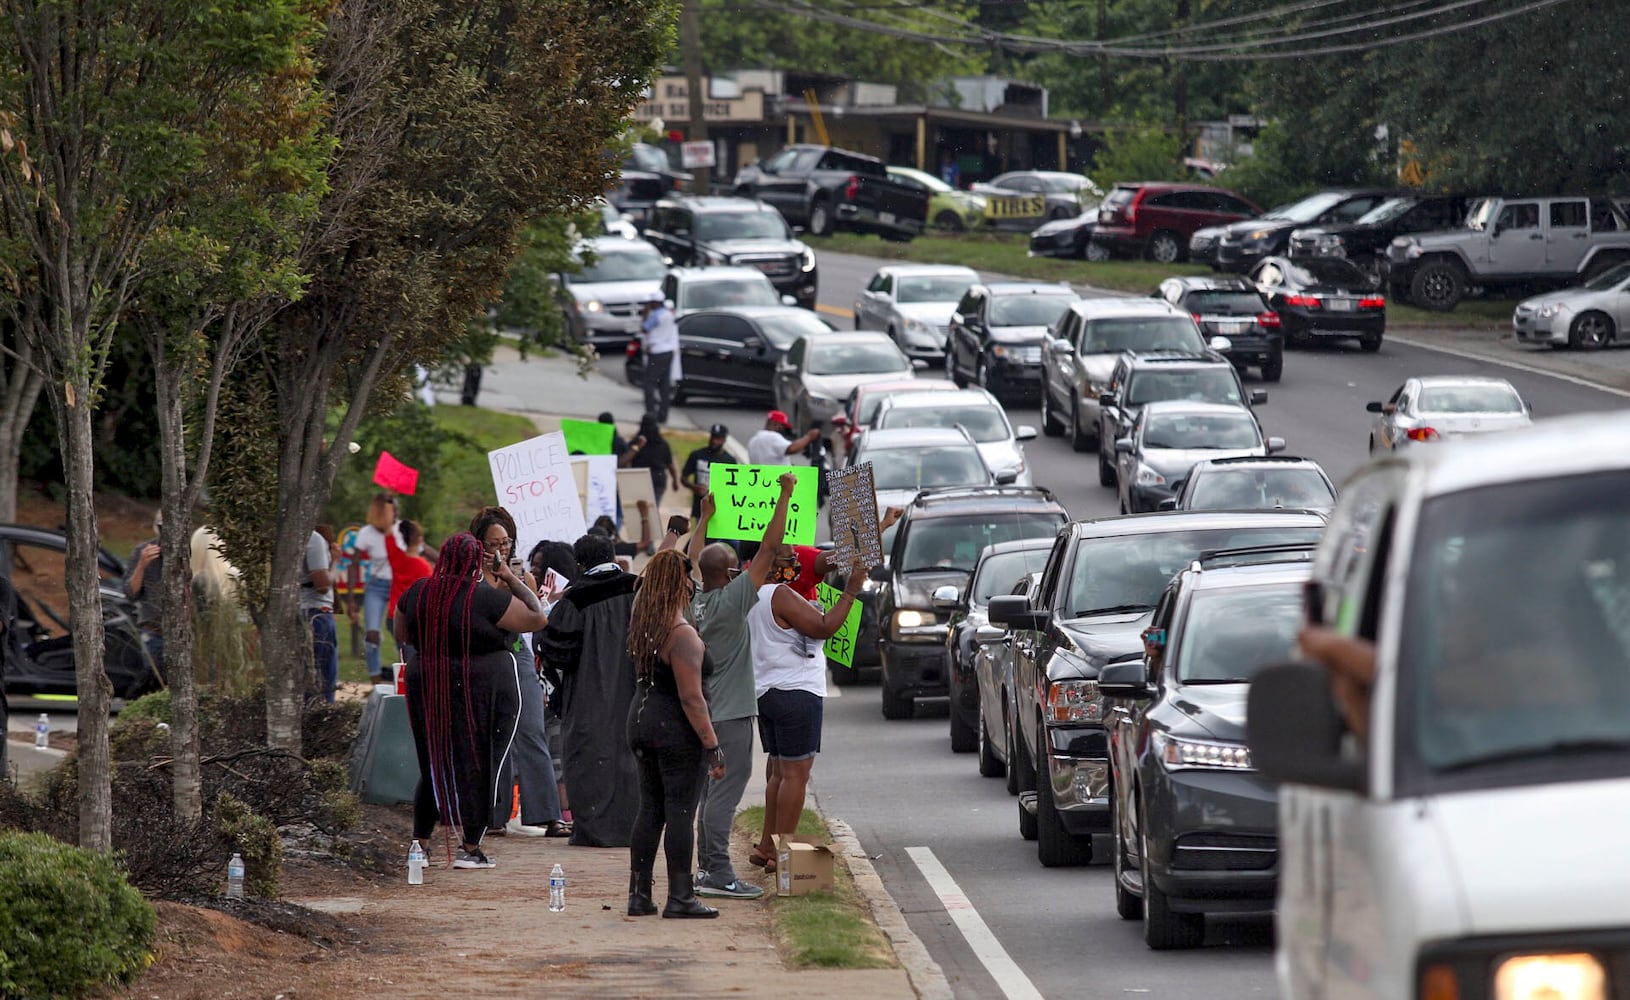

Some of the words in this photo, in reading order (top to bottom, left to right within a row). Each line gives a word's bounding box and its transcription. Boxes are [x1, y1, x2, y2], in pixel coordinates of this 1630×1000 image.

[991, 197, 1042, 214] TIRES
[494, 445, 564, 482] POLICE
[725, 468, 739, 486] I
[748, 469, 790, 487] Jus
[506, 474, 558, 504] STOP
[731, 494, 776, 509] Want
[514, 499, 571, 528] ILLING
[737, 515, 797, 537] Liv!!
